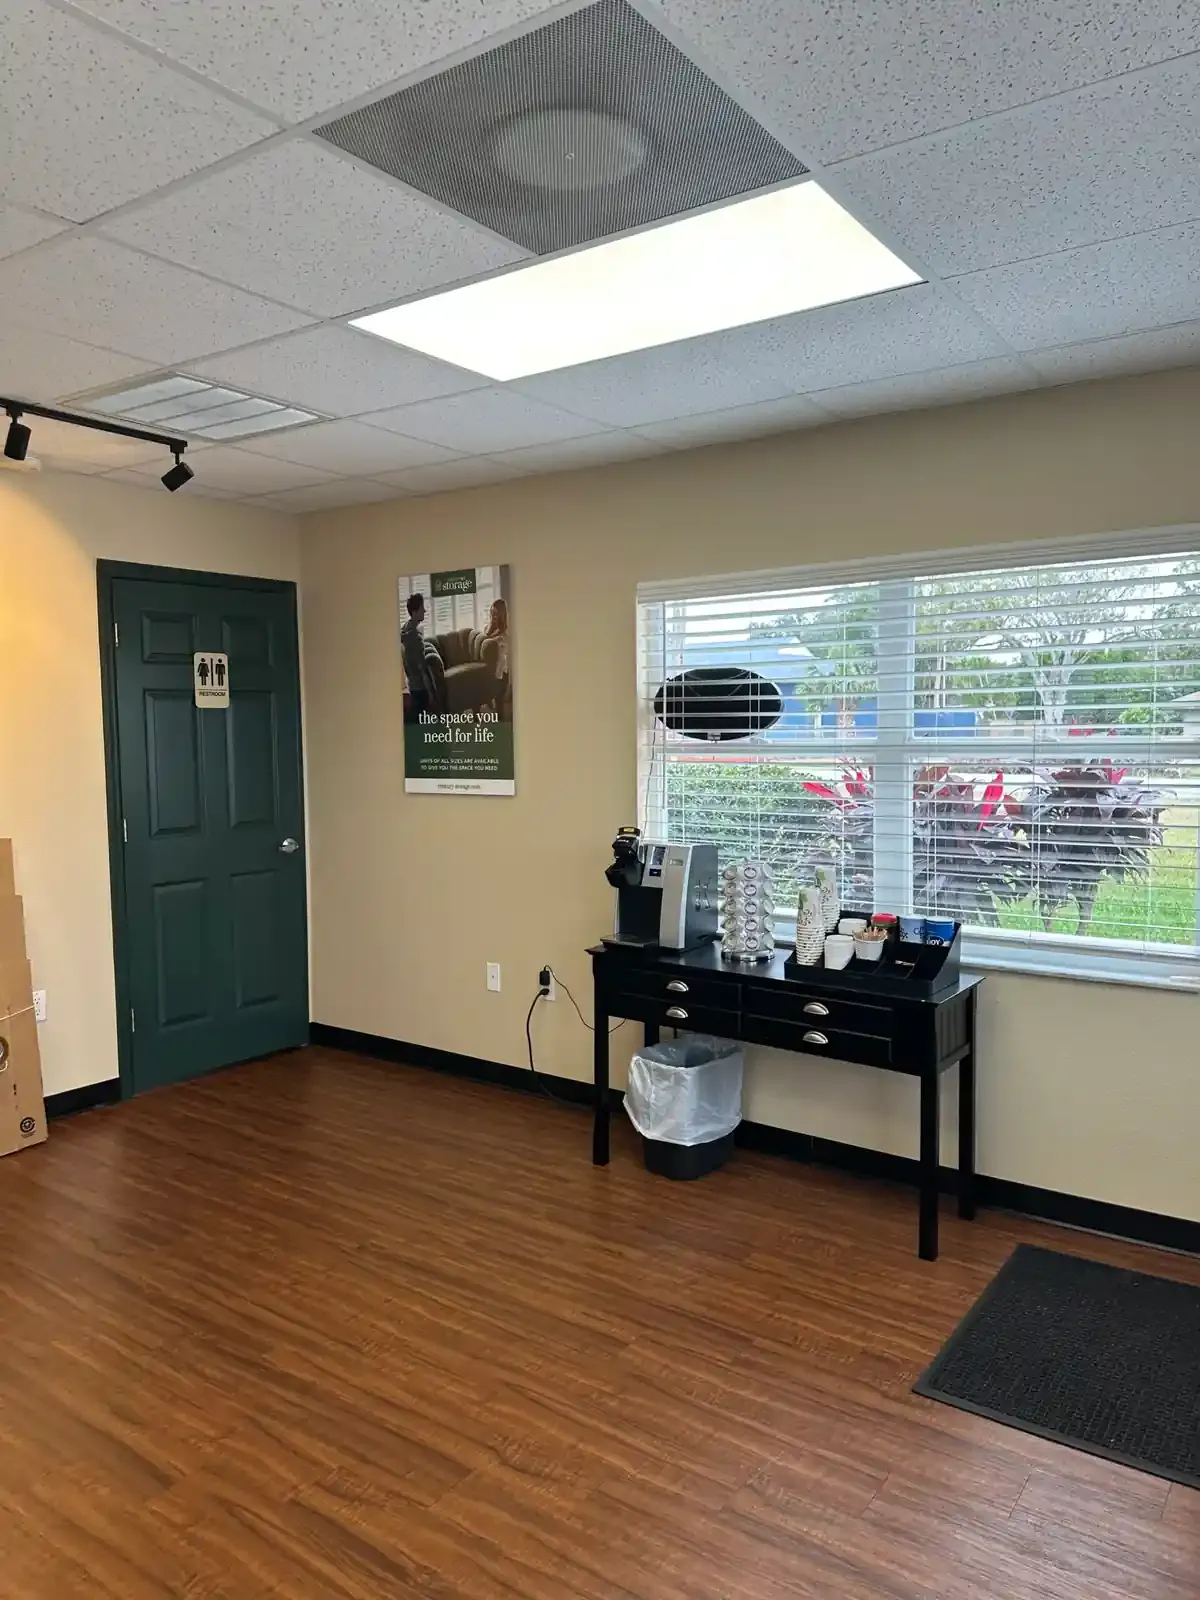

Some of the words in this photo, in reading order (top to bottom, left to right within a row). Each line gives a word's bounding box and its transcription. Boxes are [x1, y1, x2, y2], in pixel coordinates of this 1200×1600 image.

[442, 579, 473, 592] storage
[419, 710, 438, 724] the
[439, 712, 474, 728] space
[476, 712, 499, 727] you
[424, 728, 452, 742] need
[455, 728, 472, 742] for
[474, 728, 494, 742] life
